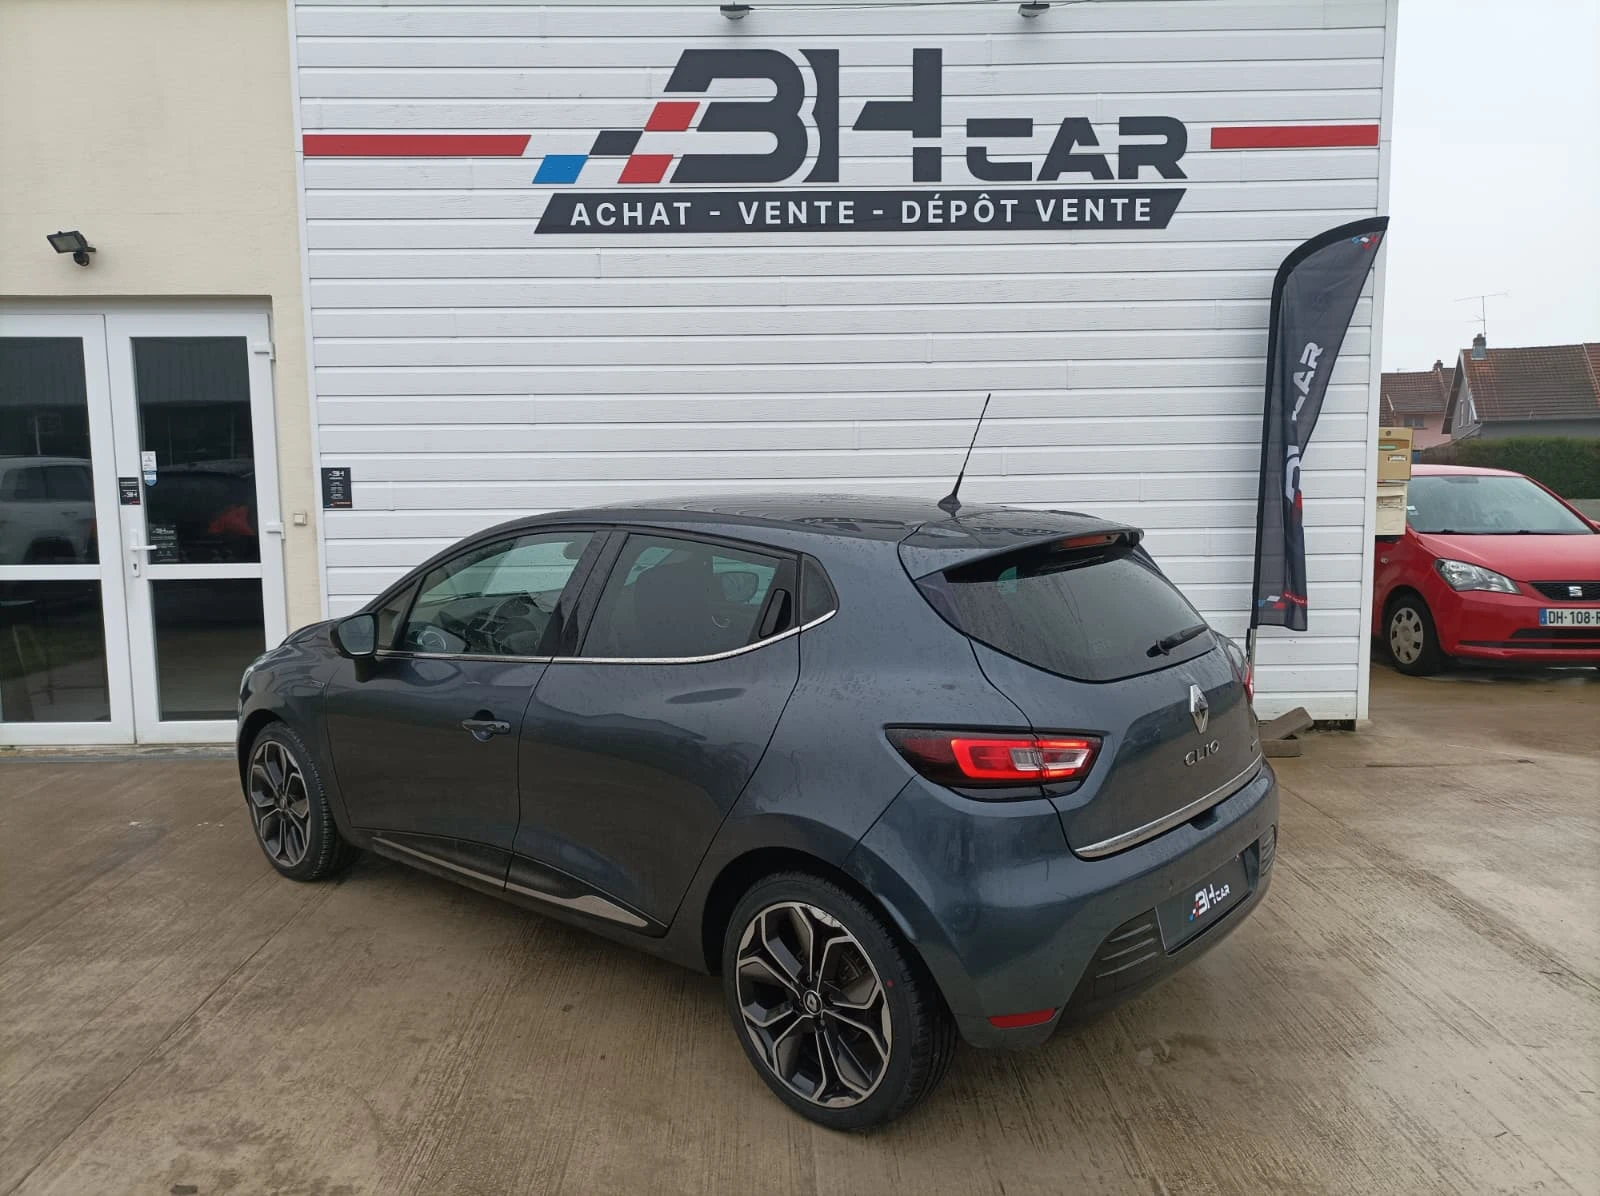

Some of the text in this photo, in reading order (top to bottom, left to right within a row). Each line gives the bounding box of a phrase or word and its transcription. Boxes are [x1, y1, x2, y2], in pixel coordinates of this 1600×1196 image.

[966, 115, 1188, 181] CAR
[570, 202, 692, 226] ACHAT
[738, 201, 855, 225] VENTE
[901, 193, 1019, 224] DÉPÔT
[1035, 198, 1151, 222] VENTE
[1184, 739, 1220, 767] CLIO
